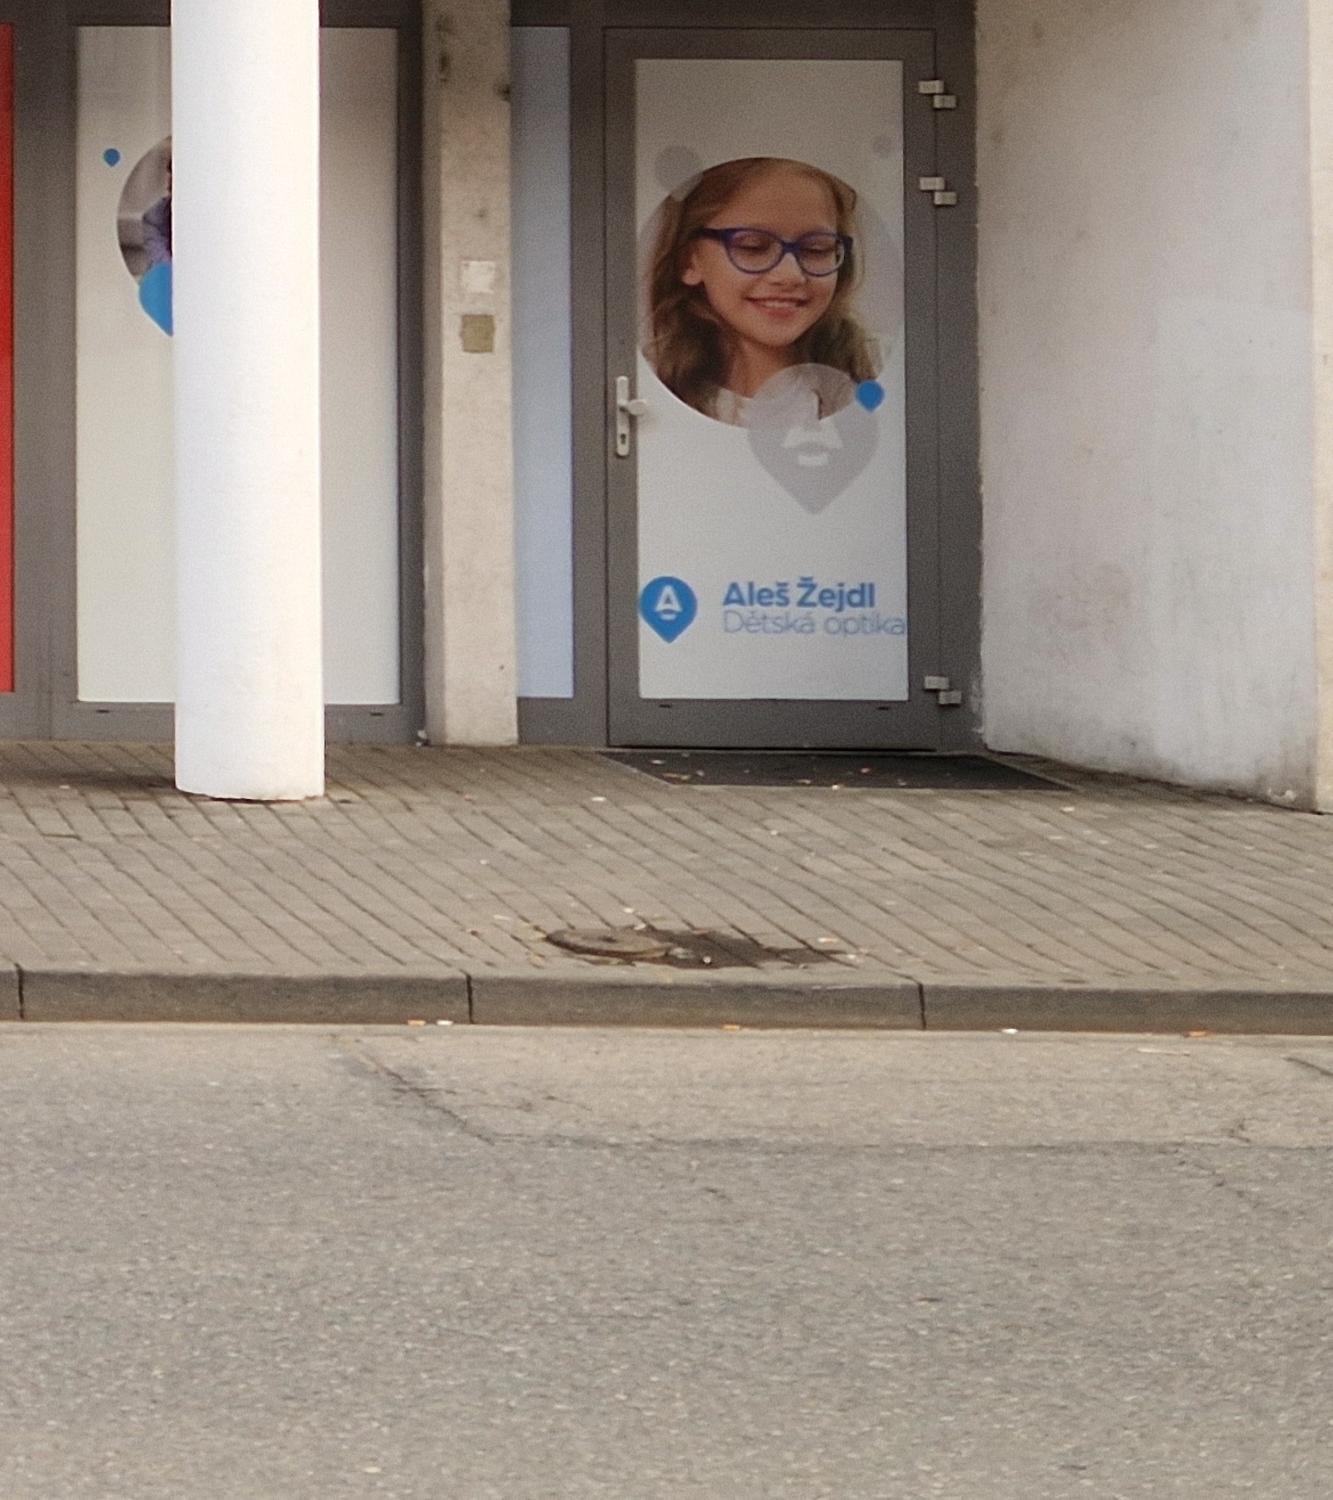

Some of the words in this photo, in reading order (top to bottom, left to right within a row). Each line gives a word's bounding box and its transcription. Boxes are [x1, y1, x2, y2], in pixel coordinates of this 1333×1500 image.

[722, 581, 791, 608] Aleš
[796, 576, 876, 613] Žejdl
[723, 609, 816, 635] Dětská
[824, 612, 906, 637] optika
